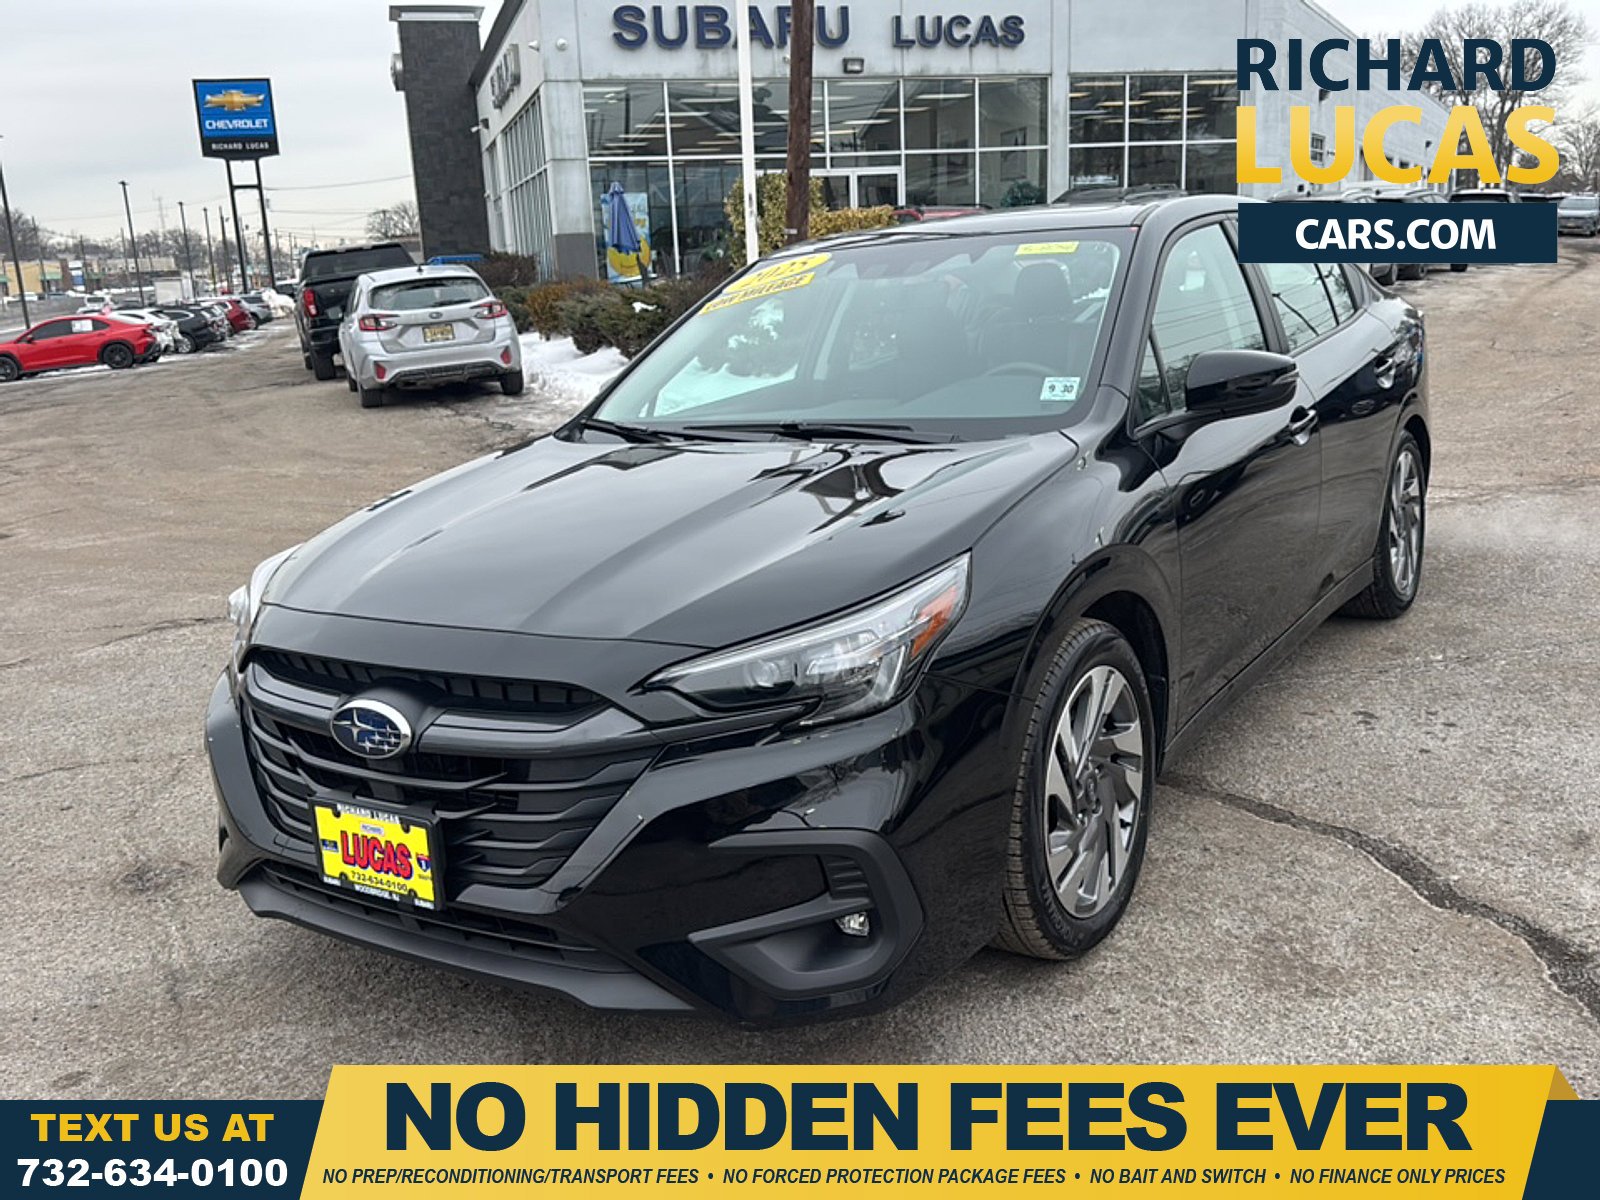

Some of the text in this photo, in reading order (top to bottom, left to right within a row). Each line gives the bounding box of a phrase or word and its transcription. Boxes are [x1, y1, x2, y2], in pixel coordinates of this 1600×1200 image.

[892, 15, 1026, 48] LUCAS
[204, 119, 269, 130] CHEVROLET
[211, 141, 270, 151] RICHARD LUCAS
[340, 829, 414, 881] LUCAS
